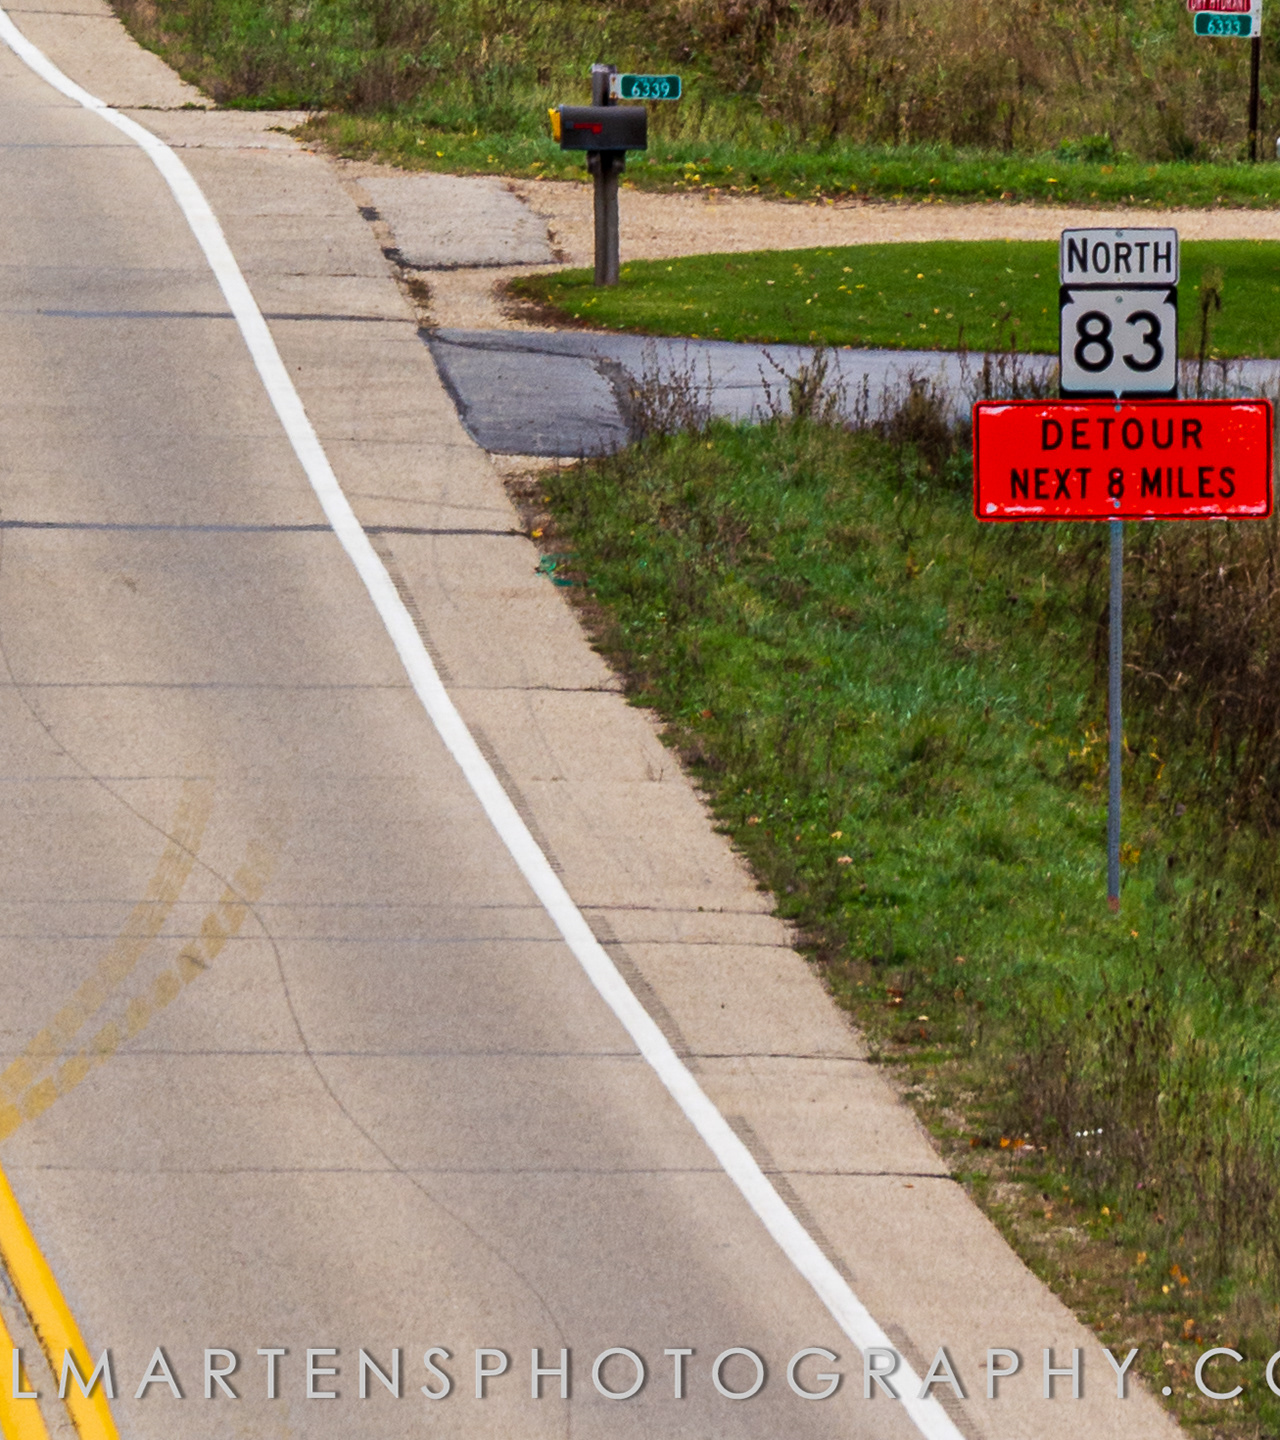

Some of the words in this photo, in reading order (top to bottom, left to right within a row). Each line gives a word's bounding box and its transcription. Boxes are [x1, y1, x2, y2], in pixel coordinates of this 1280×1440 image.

[631, 81, 670, 98] 6339
[1067, 238, 1172, 274] NORTH
[1074, 310, 1164, 373] 83
[1041, 418, 1203, 450] DETOUR
[1010, 468, 1092, 500] NEXT
[1107, 471, 1124, 500] 8
[1140, 466, 1236, 499] MILES
